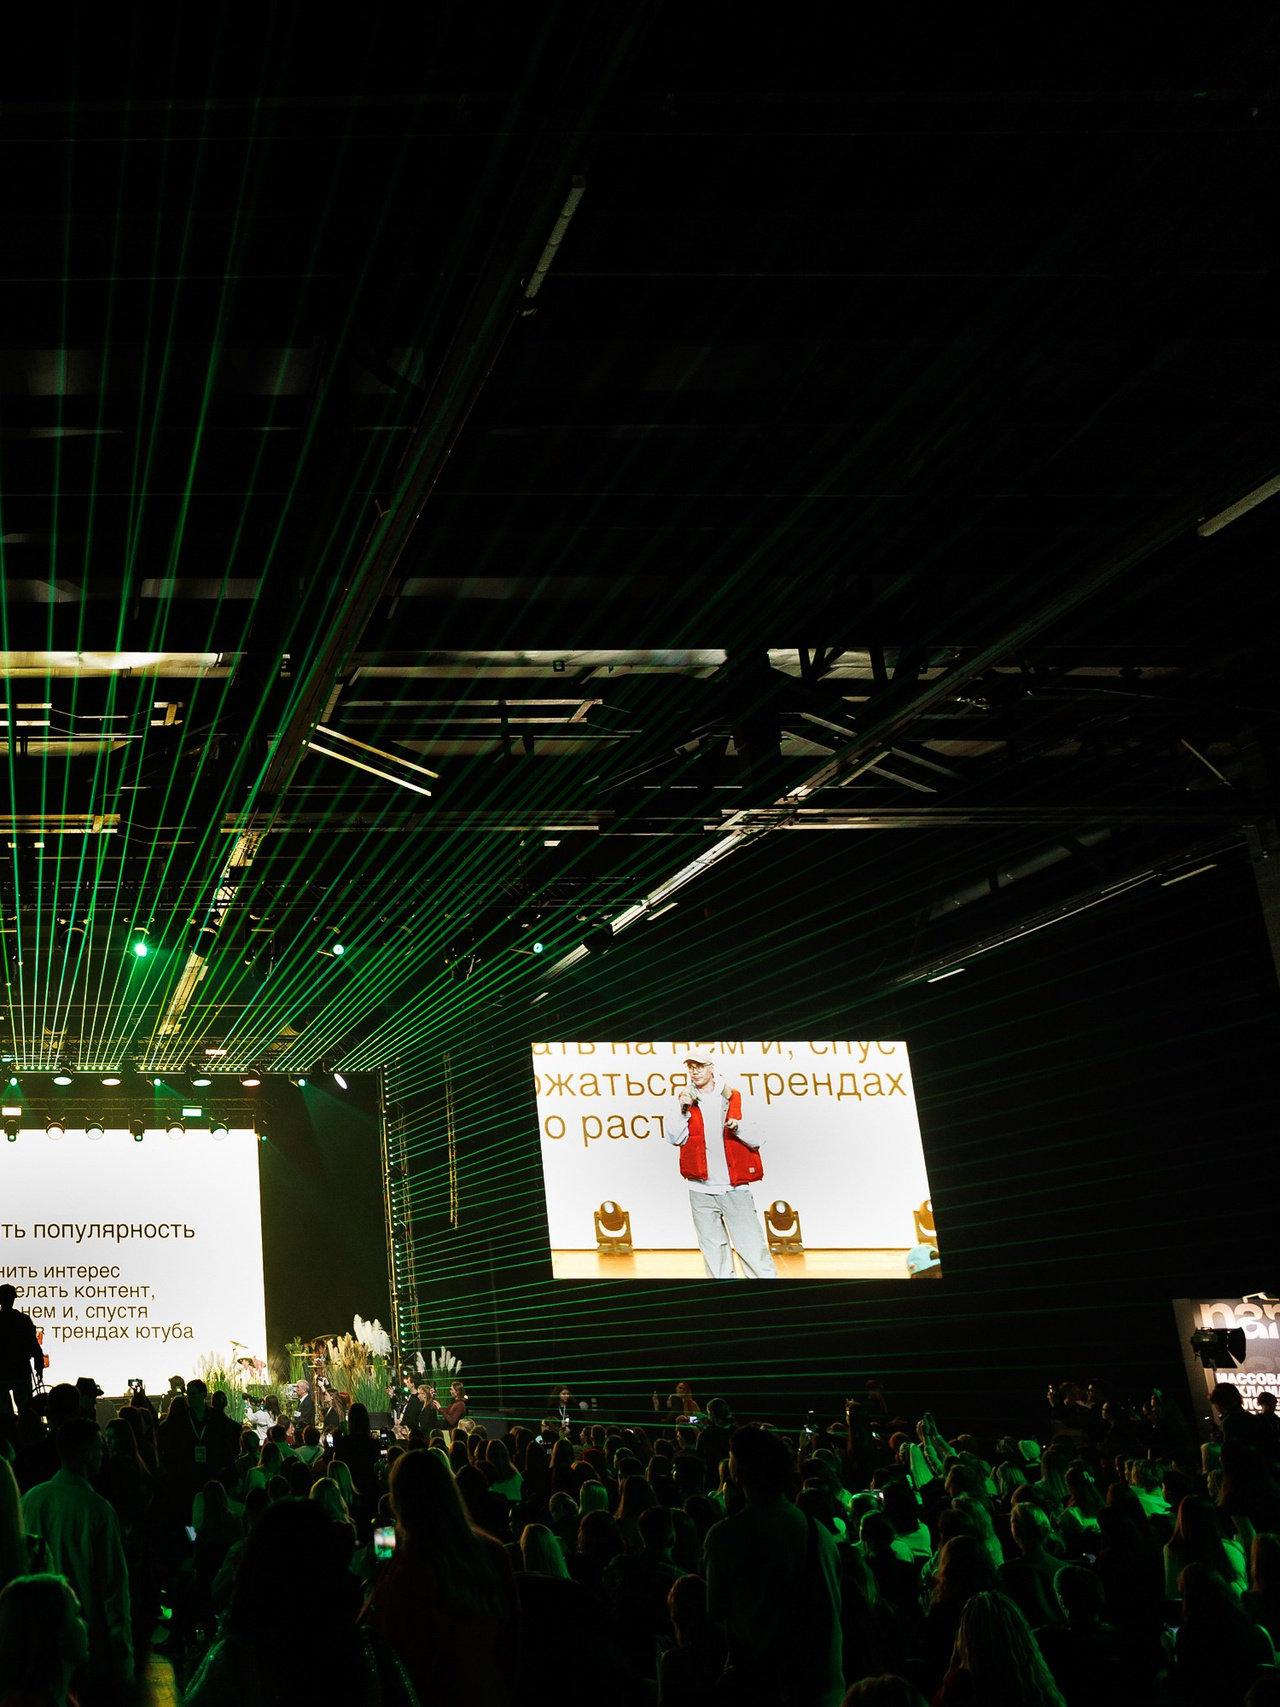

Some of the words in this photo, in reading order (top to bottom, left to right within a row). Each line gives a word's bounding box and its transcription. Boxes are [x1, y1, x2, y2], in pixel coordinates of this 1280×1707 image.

[740, 1072, 907, 1105] трендах
[544, 1115, 567, 1139] о
[33, 1223, 196, 1243] популярность
[43, 1265, 120, 1282] интерес
[14, 1286, 68, 1298] елать
[74, 1286, 156, 1301] контент,
[62, 1307, 79, 1321] и,
[85, 1306, 148, 1322] спустя
[52, 1326, 129, 1343] трендах
[135, 1323, 194, 1343] ютуба
